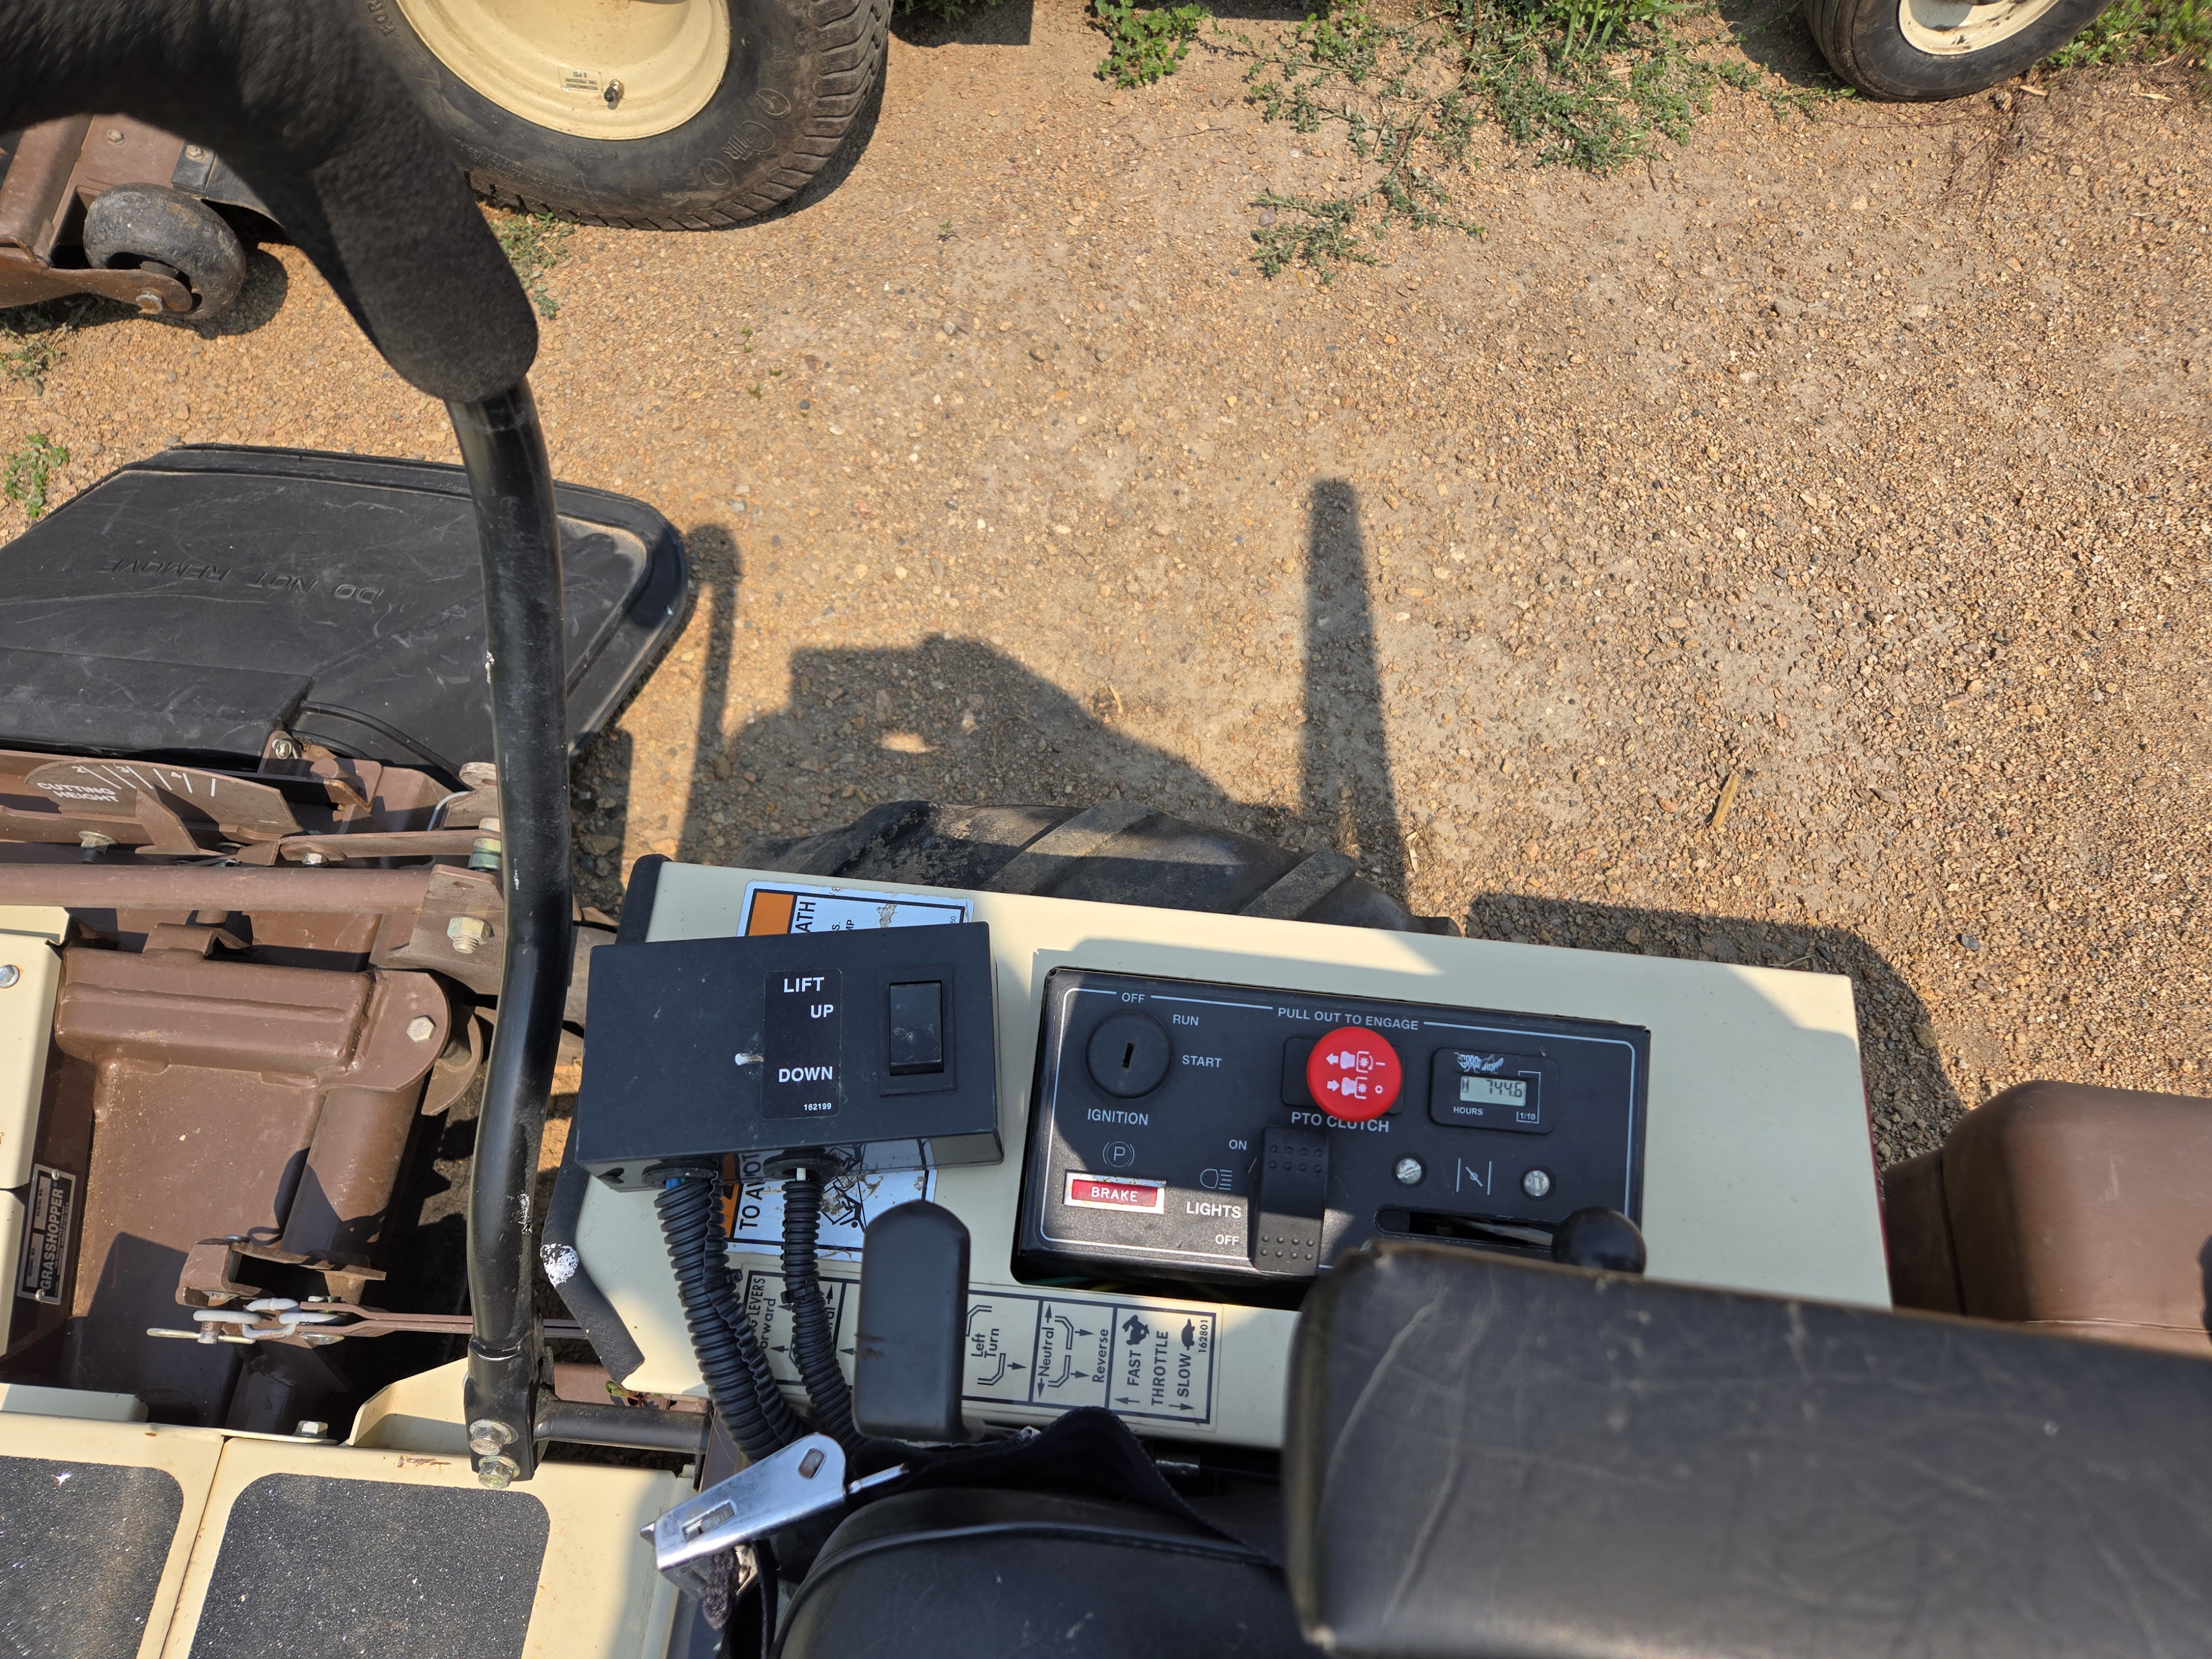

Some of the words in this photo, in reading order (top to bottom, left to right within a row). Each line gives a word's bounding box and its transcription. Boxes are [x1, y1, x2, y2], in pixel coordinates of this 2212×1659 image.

[98, 557, 231, 582] REMOVE
[246, 572, 318, 593] NOT
[333, 584, 384, 604] DO
[36, 782, 116, 795] CUTTING
[53, 790, 119, 802] HEIGHT
[784, 977, 825, 993] LIFT
[1121, 993, 1145, 1004] OFF
[811, 1004, 834, 1019] UP
[1172, 1015, 1199, 1026] RUN
[1278, 1008, 1310, 1020] PULL
[1314, 1010, 1340, 1022] OUT
[1345, 1013, 1361, 1025] TO
[1365, 1015, 1418, 1030] ENGAGE
[1182, 1055, 1222, 1067] START
[779, 1066, 833, 1083] DOWN
[1486, 1079, 1522, 1098] 744.6
[1087, 1109, 1149, 1125] IGNITION
[1291, 1112, 1322, 1126] PTO
[1453, 1107, 1483, 1115] HOURS
[1520, 1112, 1536, 1120] 1/10
[1229, 1140, 1247, 1151] ON
[1091, 1186, 1139, 1202] BRAKE
[739, 1205, 760, 1230] TO
[1187, 1202, 1241, 1218] LIGHTS
[40, 1190, 64, 1291] GRASSHOPPER
[1215, 1234, 1239, 1246] OFF
[750, 1277, 766, 1316] LEVERS
[761, 1297, 776, 1349] orward
[971, 1333, 985, 1358] Left
[984, 1328, 999, 1359] Turn
[1198, 1319, 1209, 1354] 162801
[1039, 1327, 1054, 1377] Neutral
[1092, 1328, 1109, 1383] Reverse
[1126, 1350, 1141, 1386] FAST
[1151, 1331, 1168, 1406] THROTTLE
[1177, 1353, 1191, 1397] SLOW
